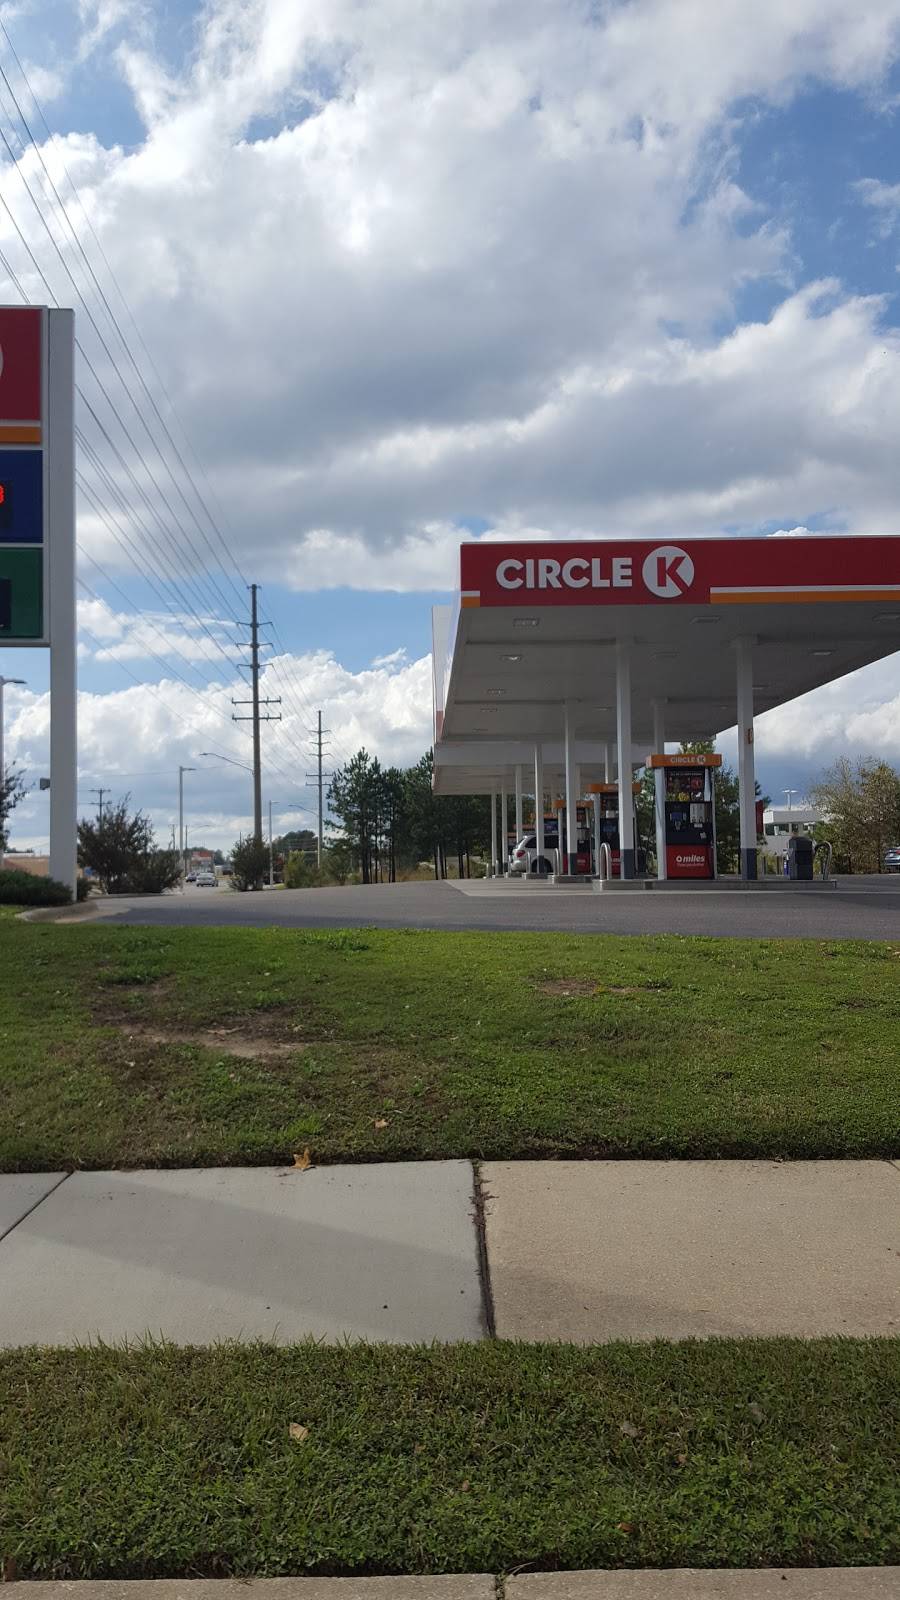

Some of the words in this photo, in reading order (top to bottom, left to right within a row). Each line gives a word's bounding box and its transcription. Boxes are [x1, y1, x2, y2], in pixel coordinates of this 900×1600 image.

[495, 558, 633, 589] CIRCLE
[646, 548, 694, 597] K
[671, 755, 697, 763] CIRCLE
